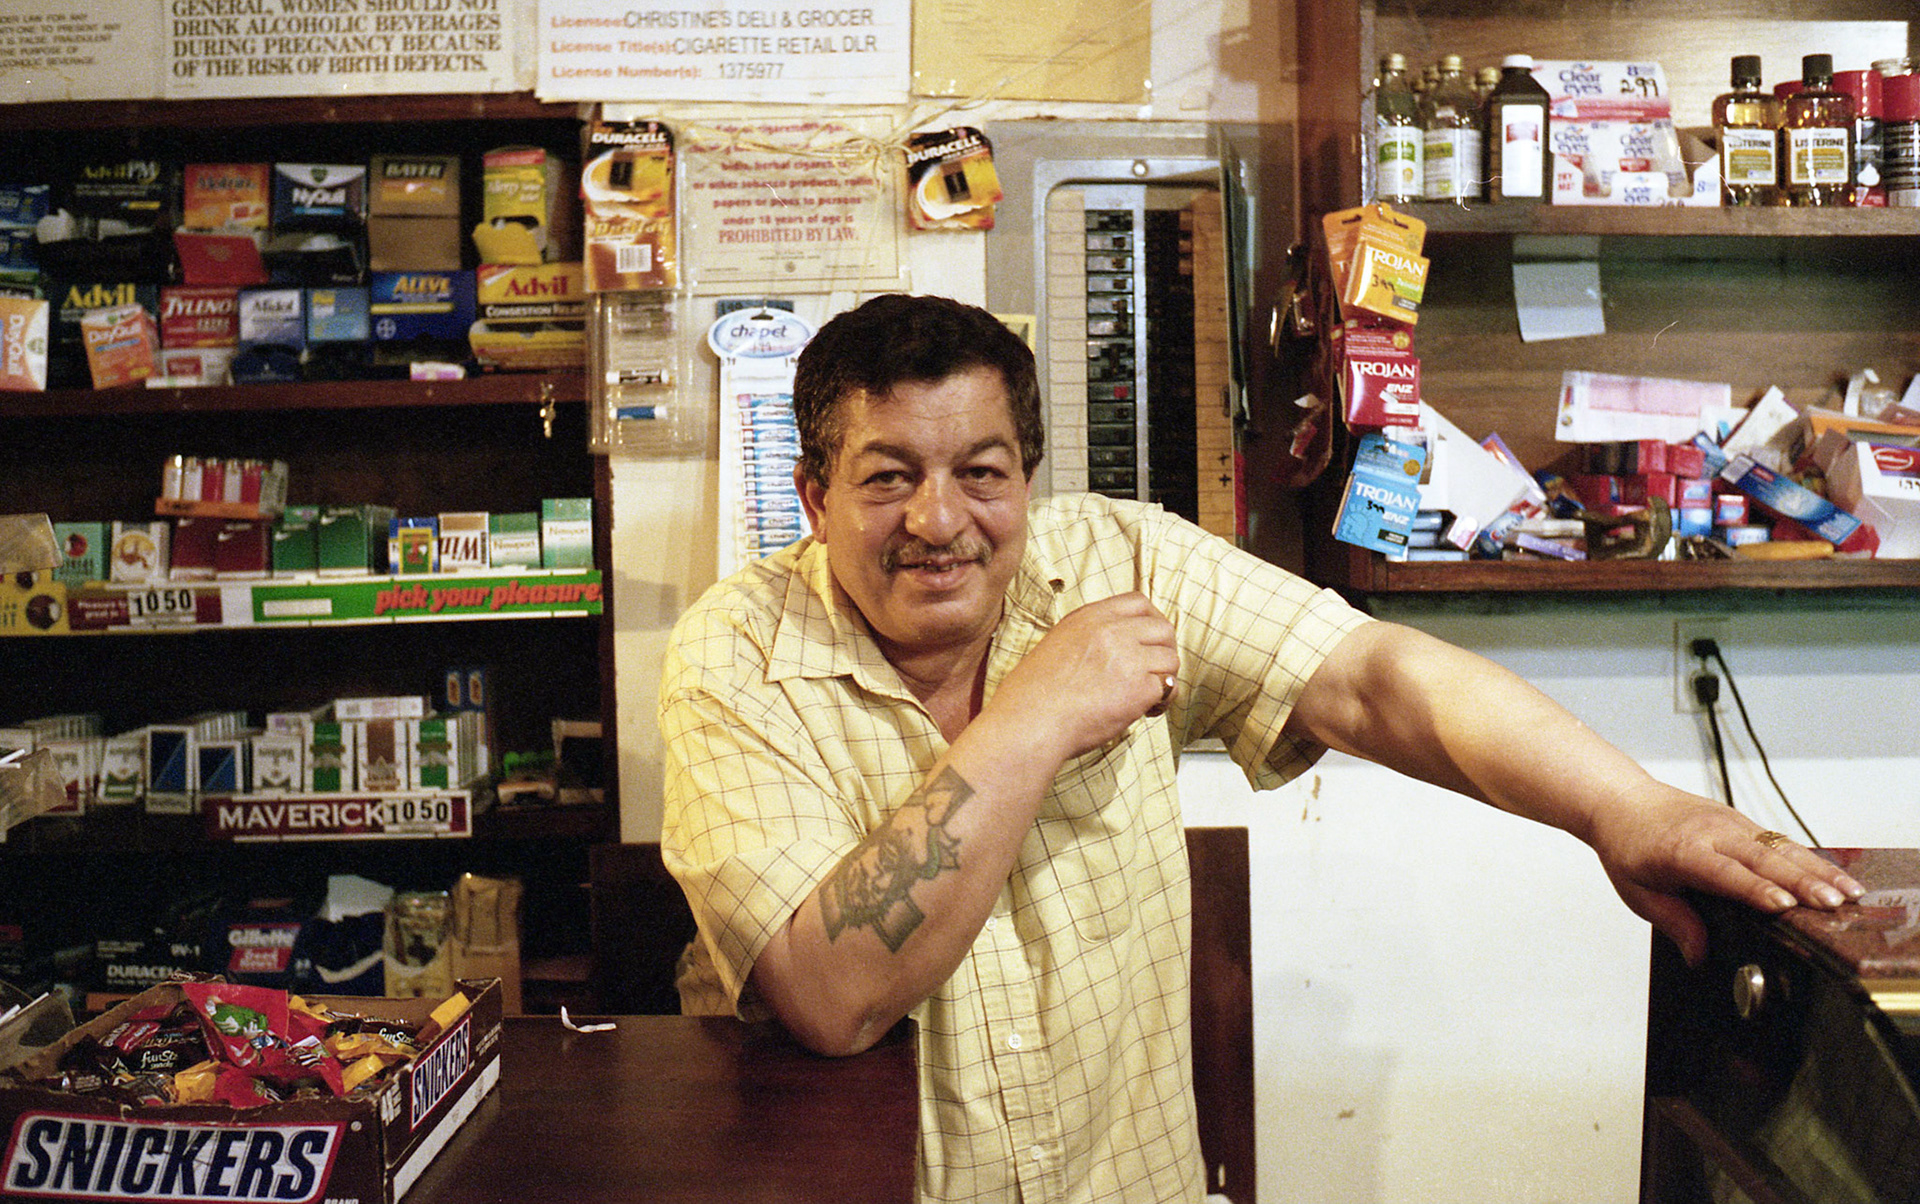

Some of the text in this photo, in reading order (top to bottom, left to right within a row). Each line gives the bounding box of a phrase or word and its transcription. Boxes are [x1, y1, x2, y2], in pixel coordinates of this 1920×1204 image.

[172, 0, 499, 16] GENERAL, WOMEN SHOULD NOT
[173, 14, 500, 36] DRINK ALCOHOLIC BEVERAGES
[737, 10, 776, 28] DELI
[782, 11, 792, 27] &
[799, 9, 874, 28] GROCER
[173, 34, 501, 56] DURING PREGNANCY BECAUSE
[551, 41, 614, 53] License
[674, 37, 770, 55] CIGARETTE
[778, 36, 836, 54] RETAIL
[843, 35, 877, 53] DLR
[173, 54, 488, 77] OF THE RISK OF BIRTH DEFECTS.
[552, 63, 784, 80] License Number(s): 1375977
[1559, 69, 1601, 82] Clear
[591, 132, 667, 144] DURACELL
[907, 135, 981, 164] DURACELL
[385, 162, 443, 178] BAYER
[709, 179, 738, 188] other
[292, 187, 347, 208] NyQuil
[713, 199, 750, 208] papers
[818, 197, 861, 206] persons
[722, 217, 754, 225] under
[775, 216, 802, 225] years
[806, 215, 818, 223] of
[821, 216, 840, 225] age
[719, 229, 802, 243] PROHIBITED
[806, 228, 821, 241] BY
[1366, 245, 1425, 277] TROJAN
[393, 275, 448, 294] ALEVE
[503, 276, 568, 297] Advil
[63, 283, 136, 309] Advil
[87, 321, 142, 347] DayQuil
[4, 314, 25, 376] DayQuil
[1350, 360, 1415, 378] TROJAN
[1385, 382, 1414, 394] ENZ
[1355, 481, 1417, 511] TROJAN
[1382, 510, 1410, 526] ENZ
[549, 526, 589, 537] Newport
[493, 535, 535, 550] Newport
[374, 584, 430, 616] pick
[430, 586, 491, 613] your
[218, 803, 384, 829] MAVERICK
[228, 928, 297, 949] Gillette
[412, 1020, 469, 1125] SNICKERS
[12, 1117, 330, 1201] SNICKERS
